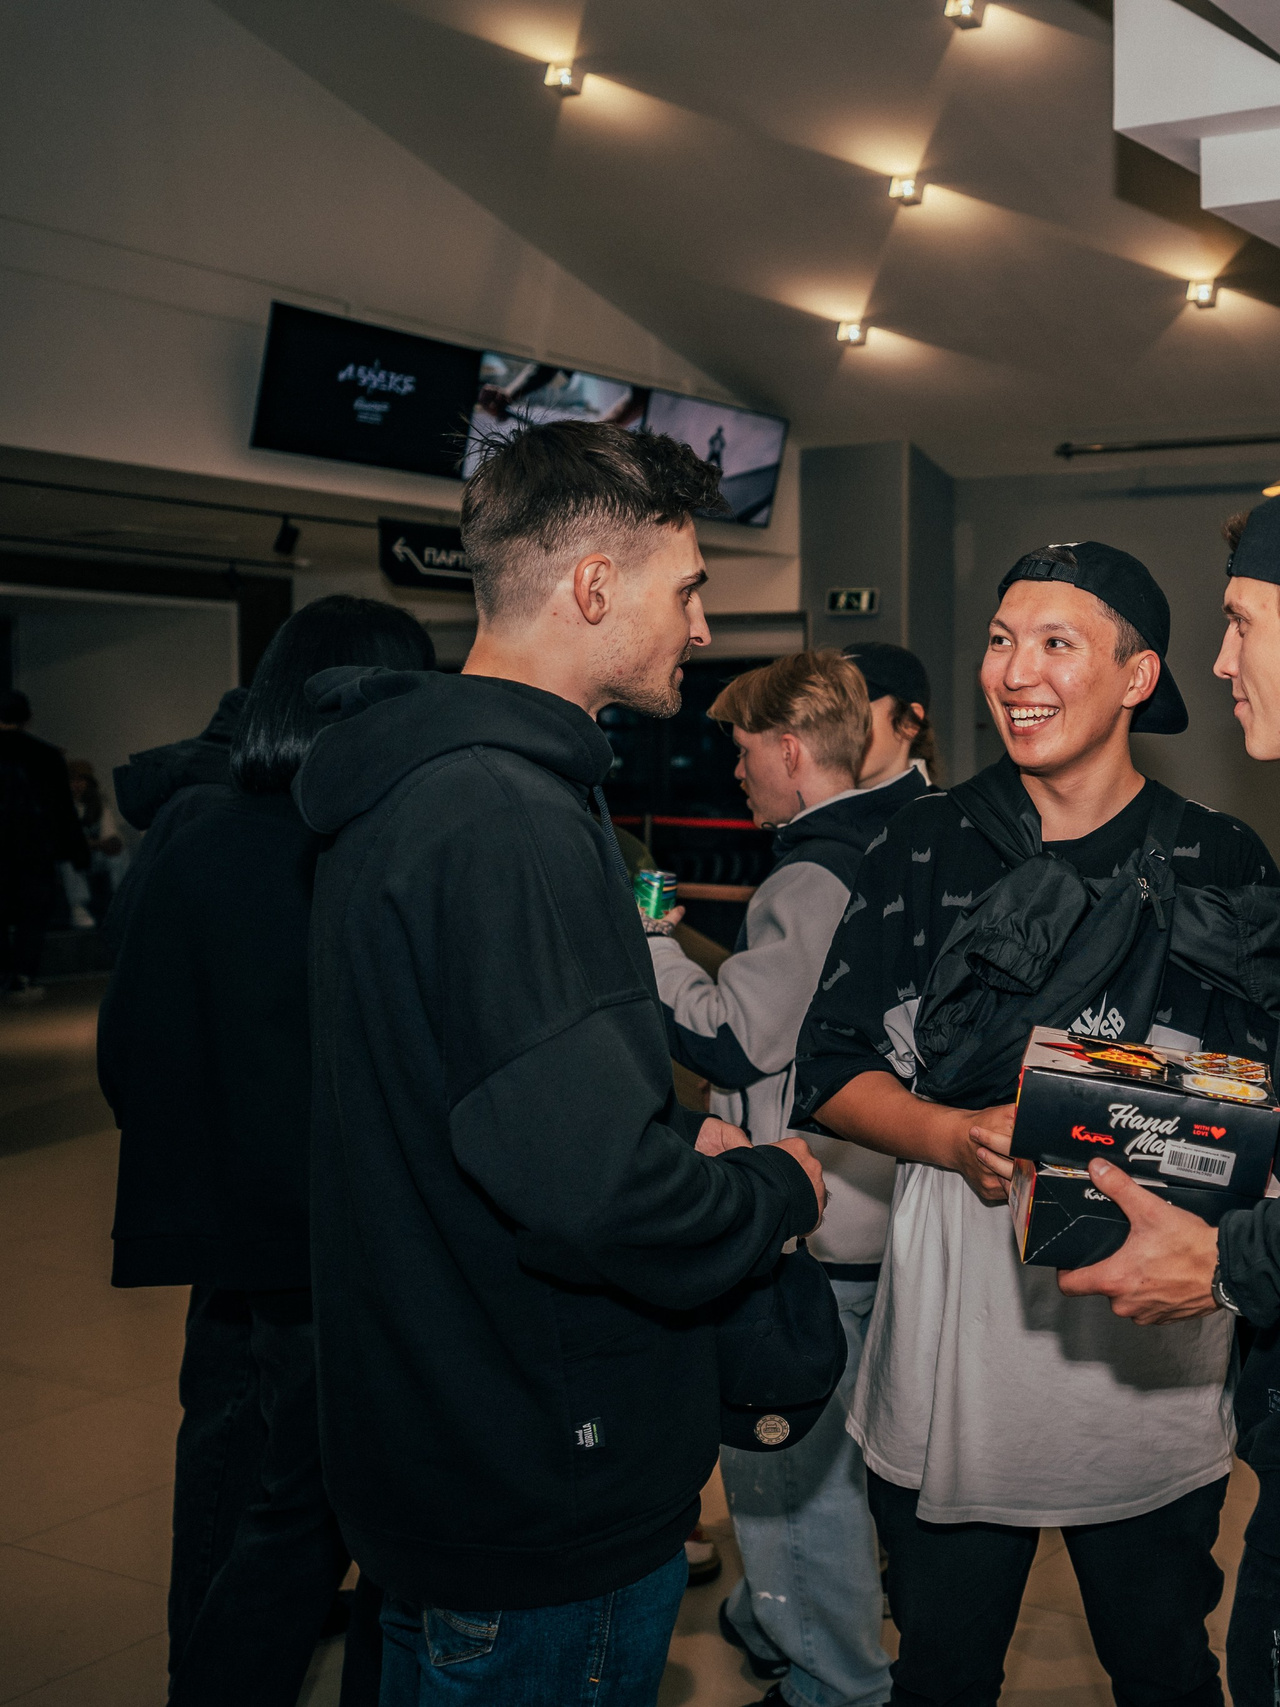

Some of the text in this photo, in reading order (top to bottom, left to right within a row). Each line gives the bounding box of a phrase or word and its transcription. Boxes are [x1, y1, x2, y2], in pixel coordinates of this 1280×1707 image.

[1100, 1007, 1126, 1040] SB
[1108, 1103, 1181, 1136] Hand
[1193, 1123, 1211, 1132] WITH
[1124, 1130, 1186, 1157] Ma
[1192, 1129, 1210, 1138] LOVE
